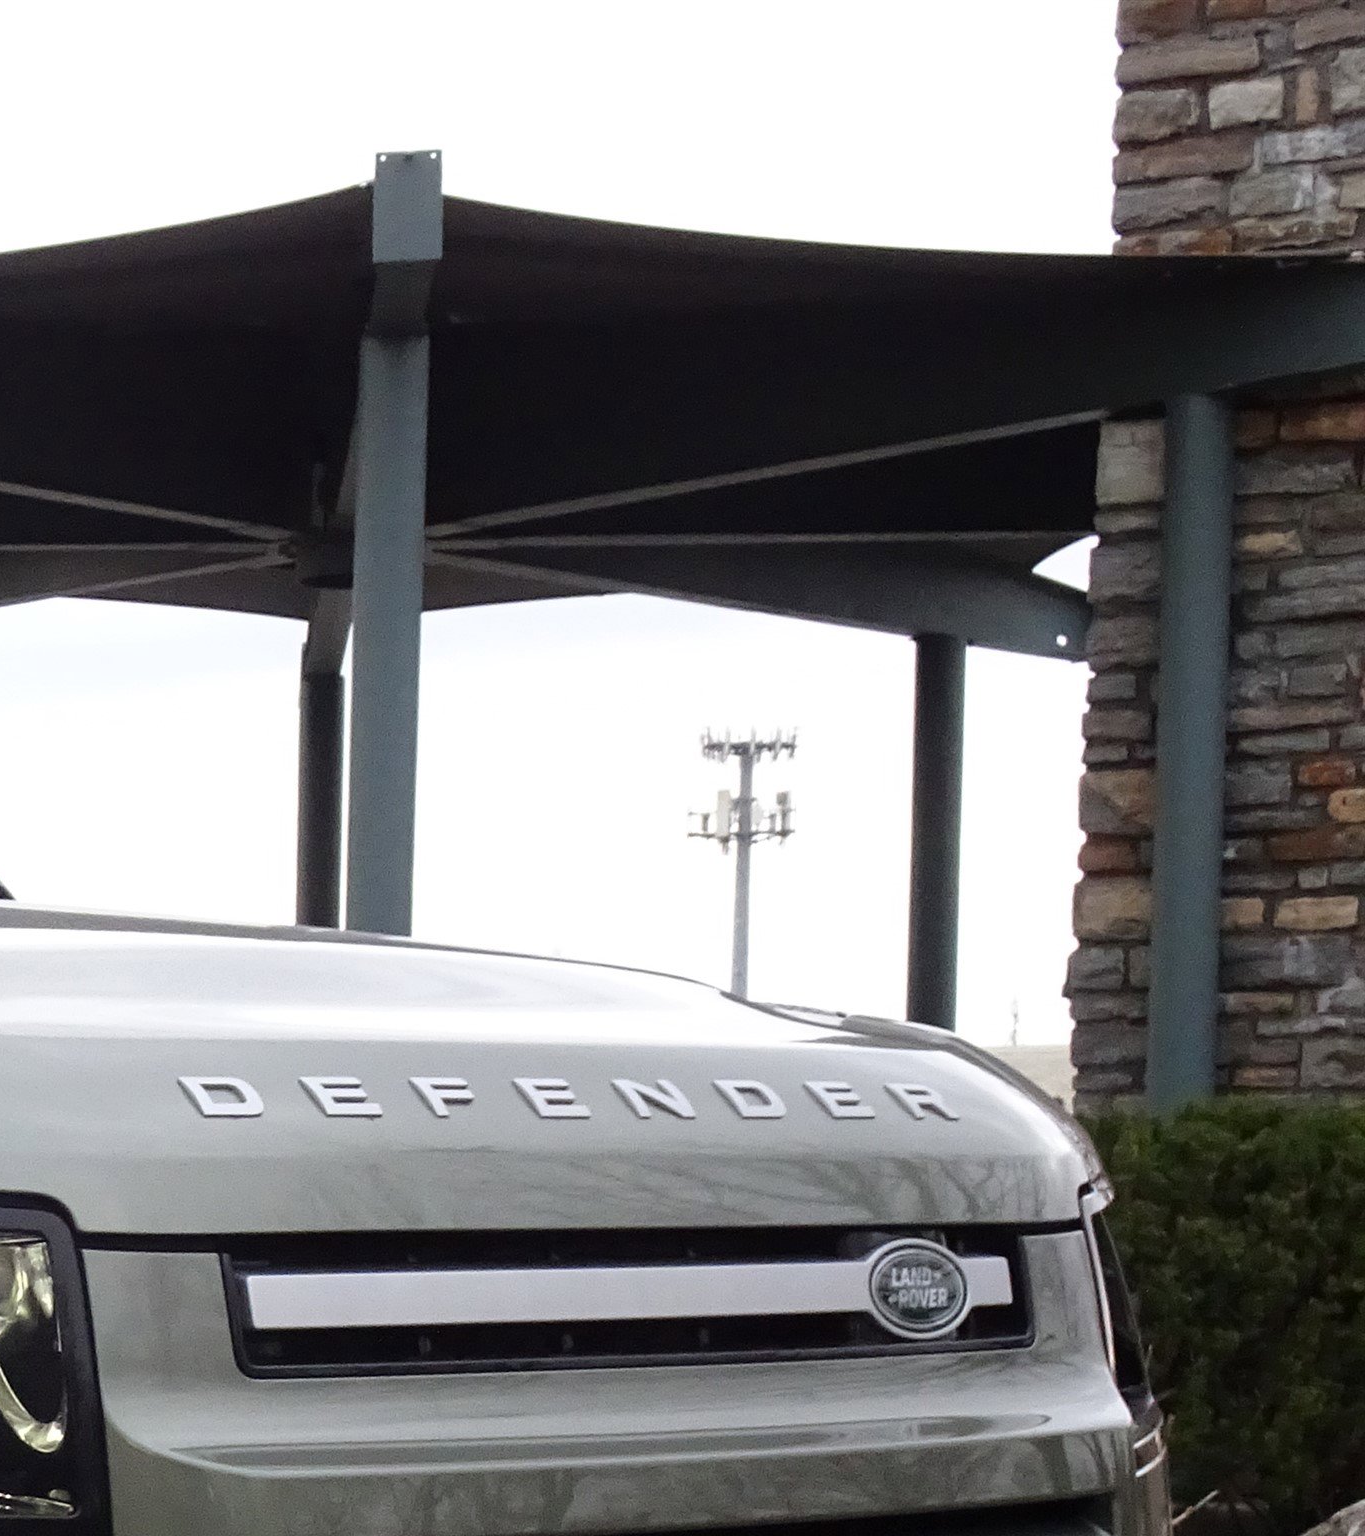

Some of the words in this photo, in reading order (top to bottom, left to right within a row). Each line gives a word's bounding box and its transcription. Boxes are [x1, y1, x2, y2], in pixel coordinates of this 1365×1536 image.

[177, 1075, 961, 1120] DEFENDER
[891, 1266, 932, 1287] LAND
[898, 1287, 948, 1308] ROVER
